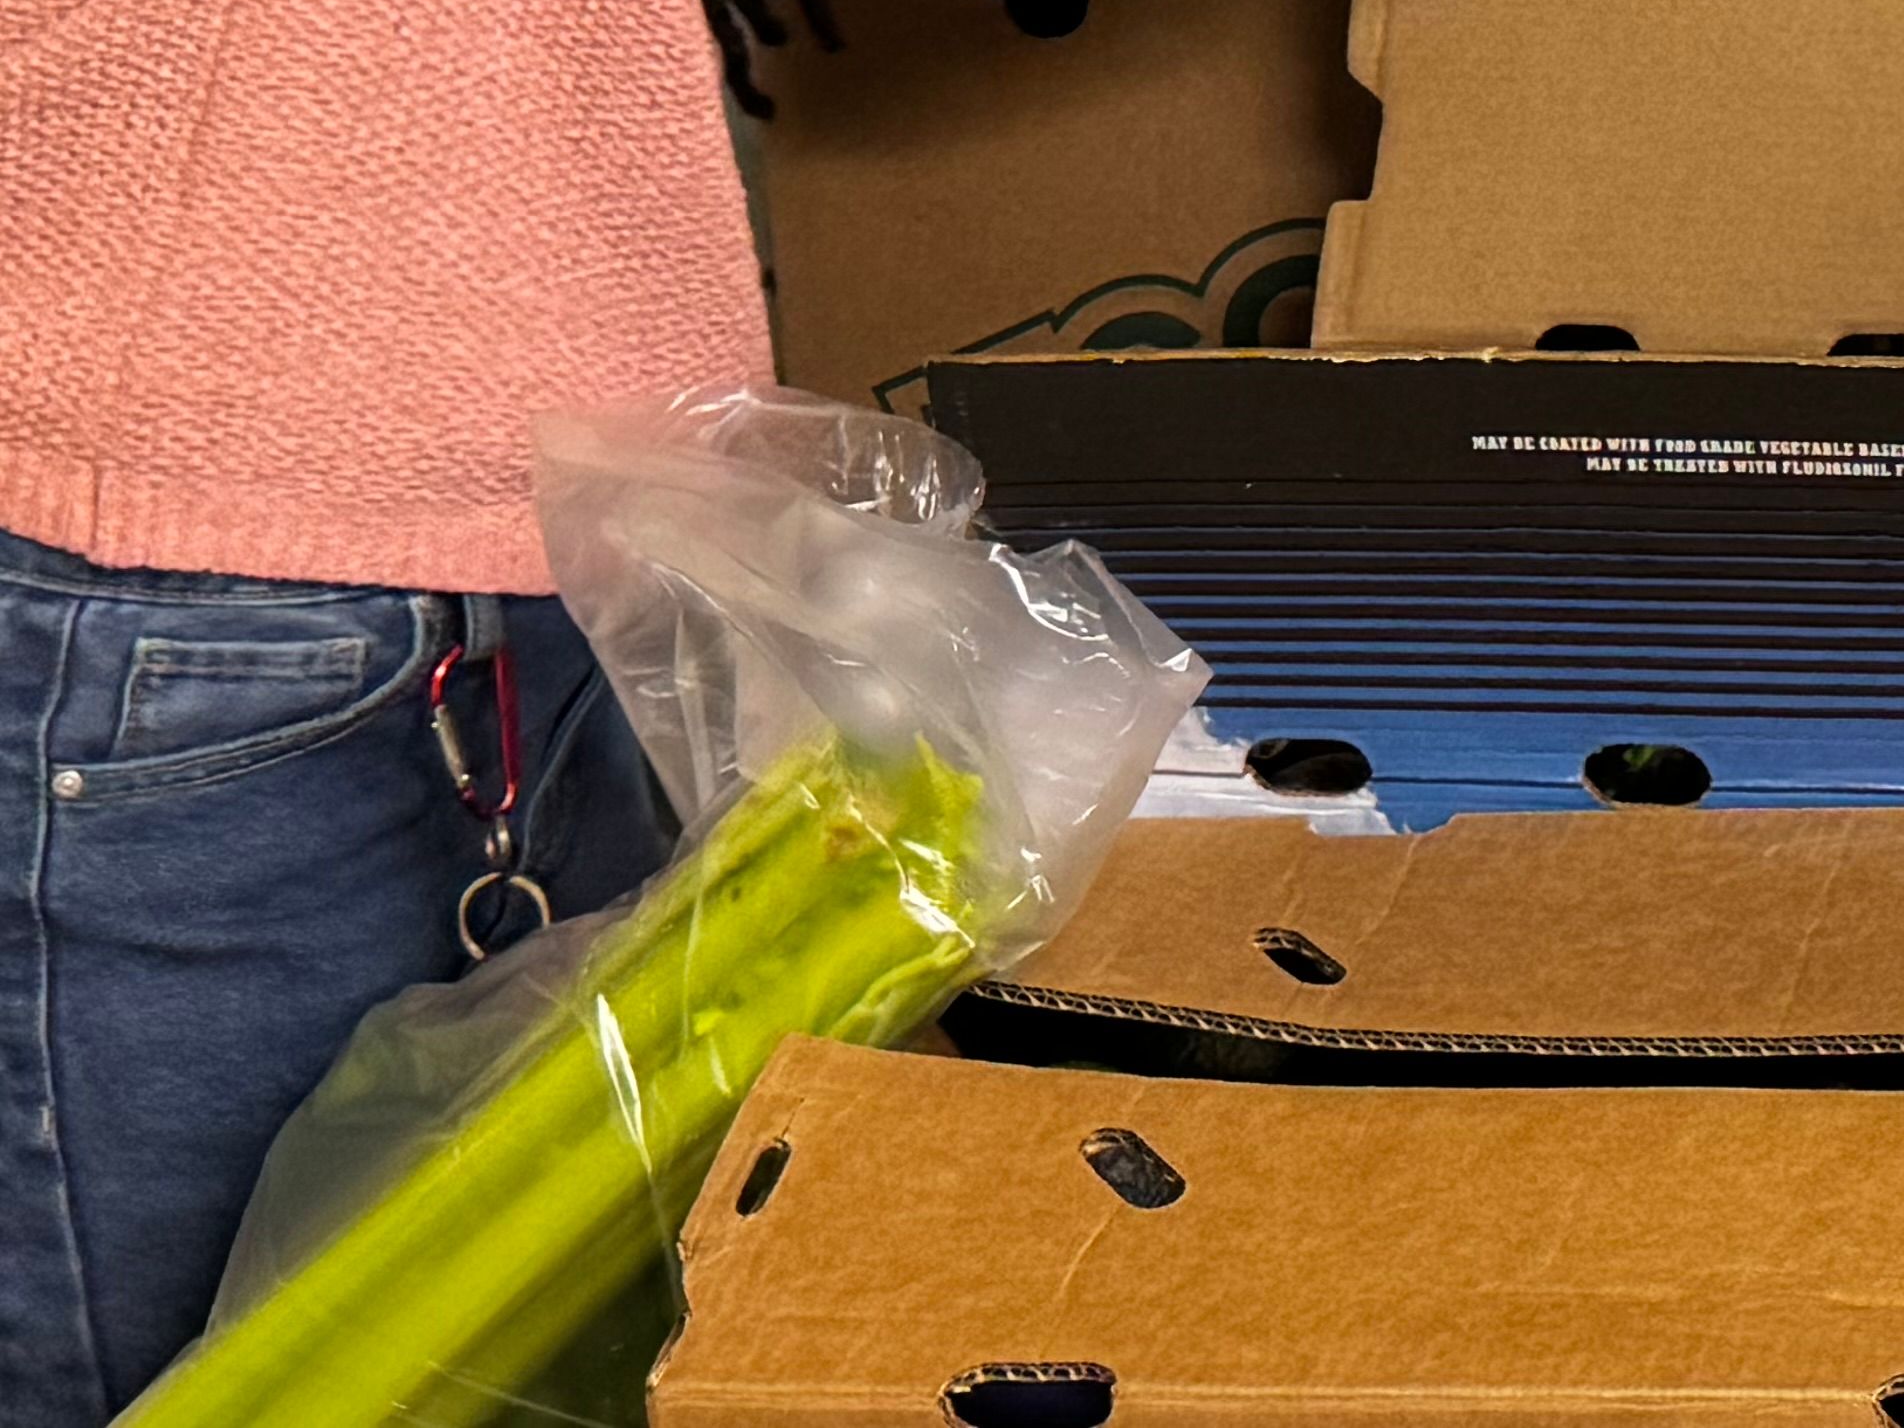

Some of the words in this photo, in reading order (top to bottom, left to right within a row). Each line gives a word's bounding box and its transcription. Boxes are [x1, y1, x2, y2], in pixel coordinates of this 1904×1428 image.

[1471, 435, 1508, 450] MAY
[1512, 436, 1536, 451] BE
[1538, 436, 1603, 452] COATED
[1605, 437, 1651, 453] WITH
[1654, 438, 1697, 453] FOOD
[1699, 439, 1756, 455] GRADE
[1759, 440, 1855, 457] VEGETABLE
[1586, 456, 1622, 472] MAY
[1626, 457, 1649, 472] BE
[1652, 458, 1730, 474] TREATED
[1732, 459, 1778, 475] WITH
